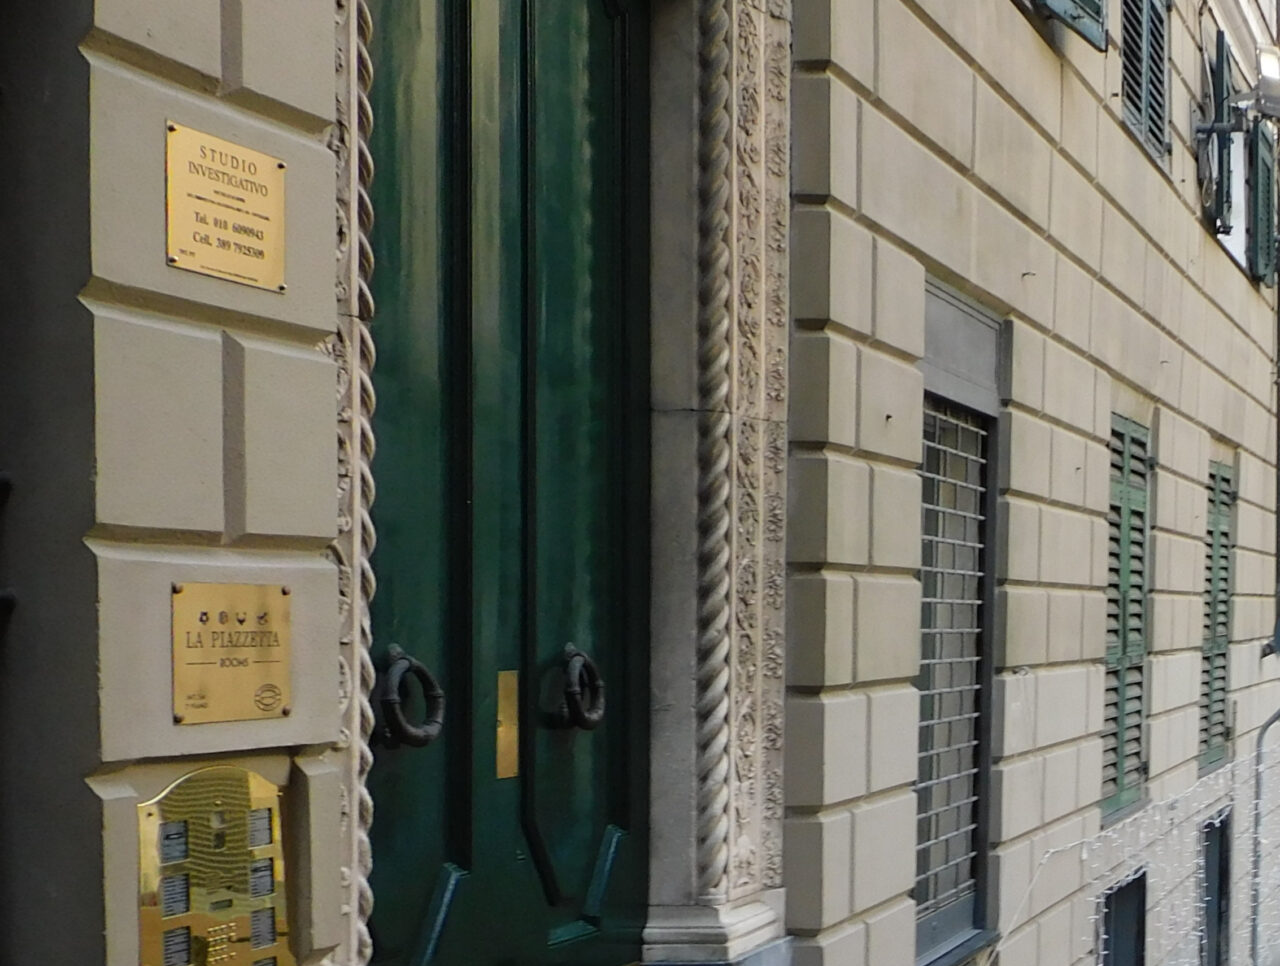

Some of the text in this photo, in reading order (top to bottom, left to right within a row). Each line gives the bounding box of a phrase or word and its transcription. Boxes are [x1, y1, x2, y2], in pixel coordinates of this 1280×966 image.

[199, 145, 258, 176] STUDIO
[187, 160, 269, 197] INVESTIGATIVO
[192, 231, 212, 247] Cell.
[185, 631, 280, 649] LA PIAZZETTA
[219, 657, 249, 668] ROOMS
